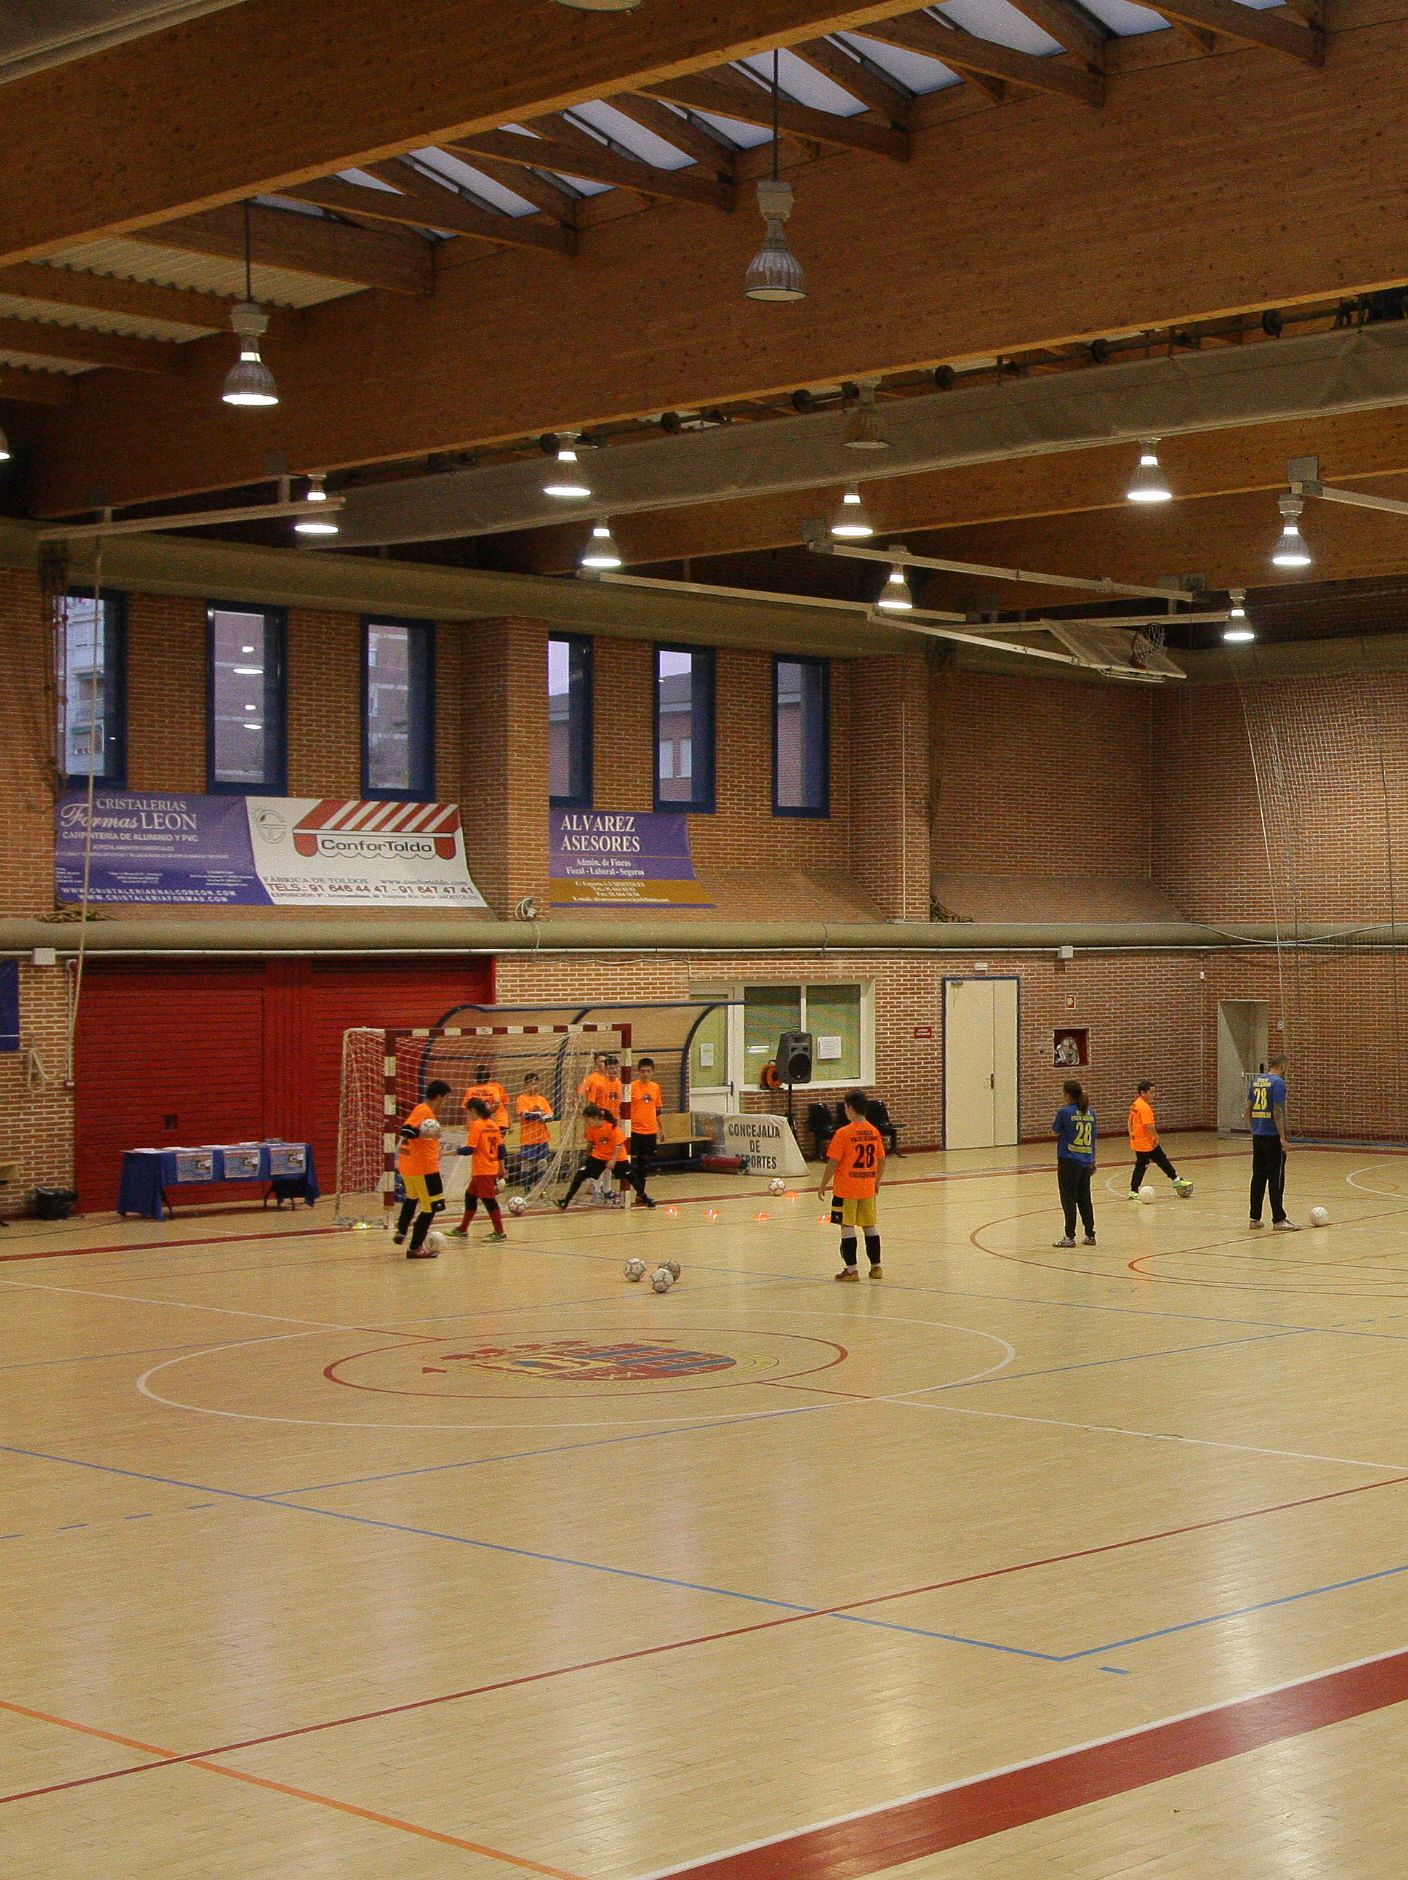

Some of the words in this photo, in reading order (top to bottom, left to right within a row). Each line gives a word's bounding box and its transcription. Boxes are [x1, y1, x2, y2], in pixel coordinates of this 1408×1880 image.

[96, 799, 187, 812] CRISTALERIAS
[60, 803, 139, 829] Formas
[140, 813, 198, 831] LEON
[560, 815, 636, 832] ALVAREZ
[120, 832, 131, 841] DE
[132, 833, 173, 842] ALUMINIO
[174, 834, 180, 842] Y
[181, 834, 199, 842] PVC
[560, 835, 641, 852] ASESORES
[320, 839, 433, 853] ConforToldo
[566, 866, 585, 875] Fiscal
[590, 867, 615, 876] Laboral
[309, 884, 325, 892] 91
[329, 885, 353, 893] 646
[356, 885, 371, 893] 44
[374, 885, 388, 893] 47
[399, 885, 414, 893] 91
[418, 886, 438, 894] 647
[443, 886, 456, 894] 47
[460, 886, 474, 894] 41
[1253, 1088, 1268, 1110] 28
[1074, 1122, 1092, 1145] 28
[749, 1140, 760, 1152] DE
[853, 1144, 876, 1168] 28
